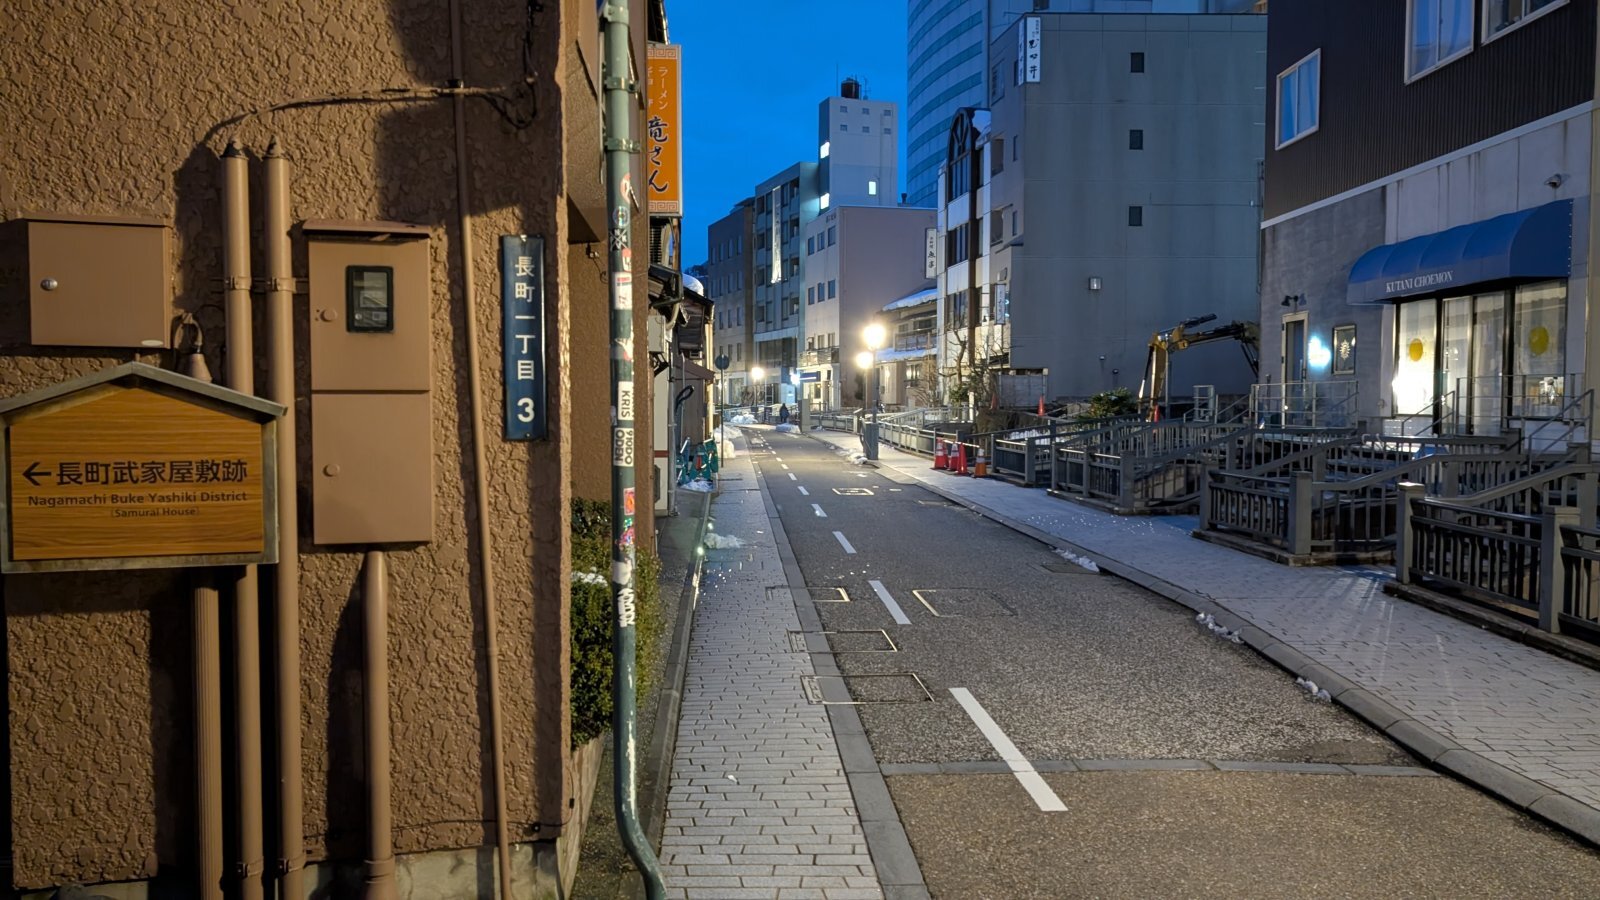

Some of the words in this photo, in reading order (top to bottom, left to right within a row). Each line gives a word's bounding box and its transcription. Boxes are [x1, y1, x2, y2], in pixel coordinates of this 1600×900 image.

[658, 66, 669, 110] ラーメン
[1386, 277, 1413, 293] KUTANI
[1414, 270, 1453, 287] CHOEMON
[515, 256, 535, 380] 長町一丁目
[517, 397, 535, 423] 3
[621, 390, 631, 418] KRIS
[615, 429, 625, 462] ODEN
[56, 459, 248, 486] 長町武家屋敷跡
[28, 493, 107, 508] Nagamachi
[110, 493, 144, 505] Buke
[148, 491, 197, 503] Yashiki
[200, 490, 248, 502] District
